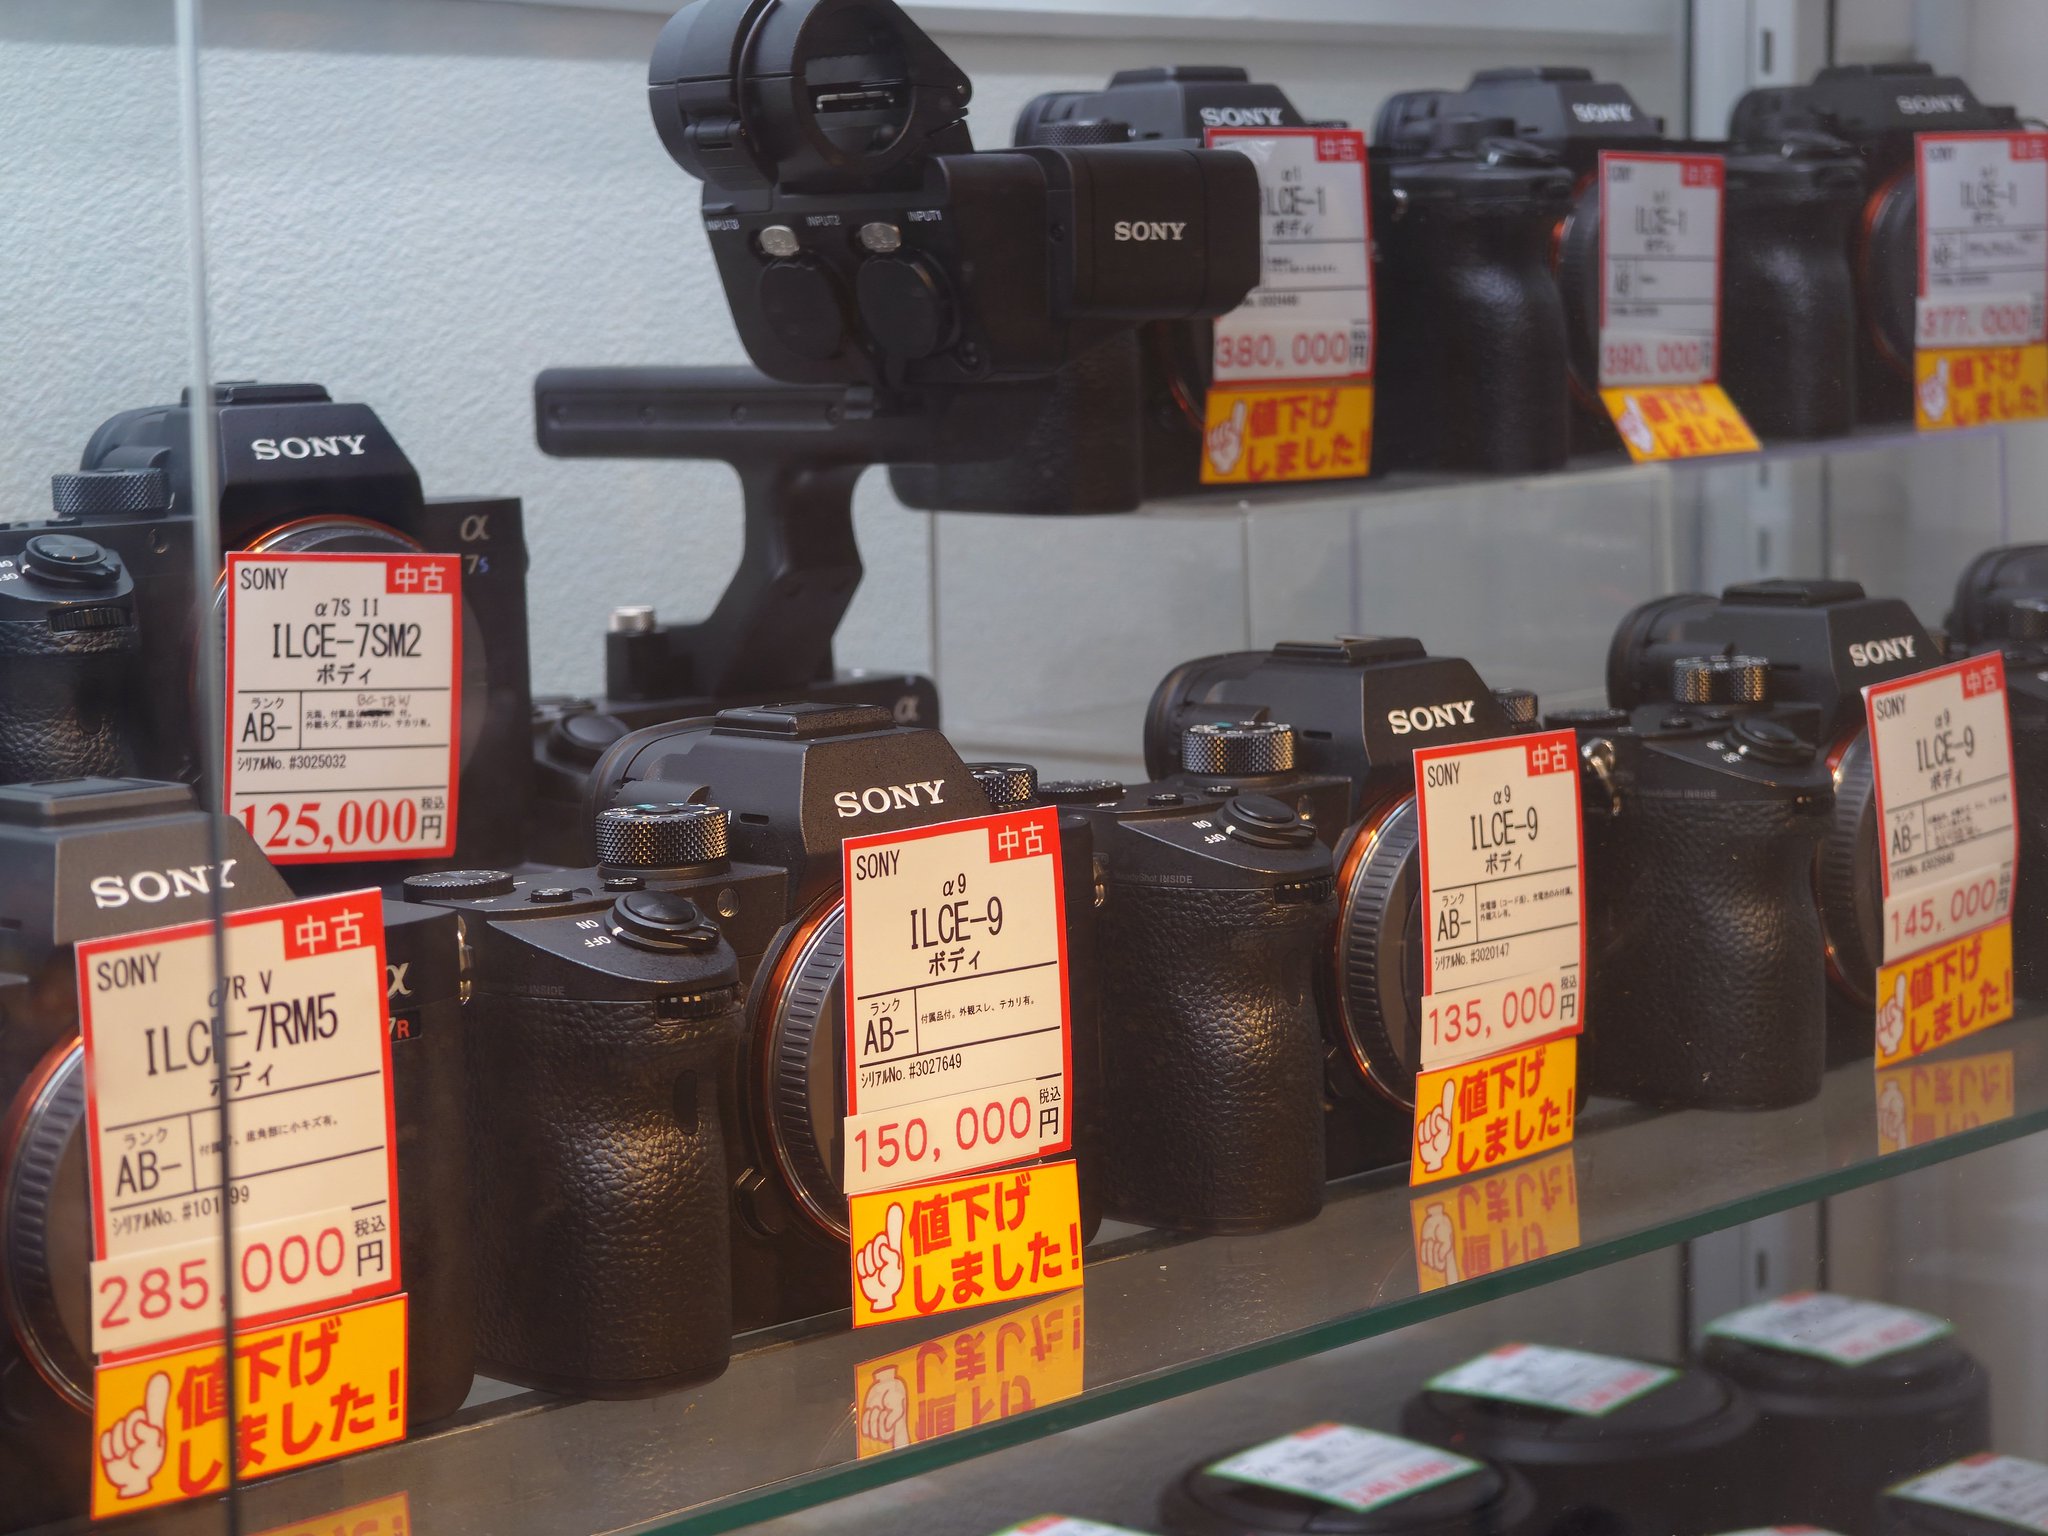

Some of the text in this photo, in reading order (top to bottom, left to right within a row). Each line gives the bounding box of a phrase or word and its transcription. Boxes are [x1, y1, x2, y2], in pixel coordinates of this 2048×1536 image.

[1200, 107, 1283, 126] SONY
[1572, 103, 1633, 122] SONY
[1897, 94, 1965, 114] SONY
[1114, 221, 1187, 241] SONY
[251, 434, 366, 461] SONY
[241, 567, 288, 590] SONY
[395, 562, 446, 593] 中古
[272, 623, 422, 658] ILCE-7SM2
[1849, 635, 1916, 667] SONY
[317, 664, 371, 685] ボディ
[1965, 665, 1997, 697] 中古
[252, 697, 284, 710] ランク
[1388, 700, 1475, 735] SONY
[1876, 695, 1906, 721] SONY
[242, 712, 292, 742] AB-
[289, 754, 347, 769] #3025032
[1532, 740, 1568, 774] 中古
[1916, 725, 1975, 772] ILCE-9
[1427, 761, 1461, 788] SONY
[834, 779, 945, 818] SONY
[240, 798, 417, 853] 125,000
[420, 815, 443, 841] 円
[1192, 819, 1213, 830] ON
[1204, 833, 1227, 844] OFF
[1470, 806, 1538, 851] ILCE-9
[997, 821, 1044, 859] 中古
[856, 849, 900, 881] SONY
[1485, 850, 1523, 875] ボディ
[943, 873, 966, 897] α9
[1160, 873, 1193, 884] INSIDE
[1441, 892, 1465, 908] ランク
[295, 908, 364, 954] 中古
[576, 919, 600, 930] ON
[910, 896, 1003, 950] ILCE-9
[1437, 908, 1471, 942] AB-
[584, 935, 612, 948] OFF
[1471, 943, 1509, 964] #3020147
[97, 952, 161, 992] SONY
[929, 947, 981, 977] ボディ
[1909, 933, 1983, 1010] 値下げ
[260, 970, 273, 994] V
[870, 997, 901, 1016] ランク
[1429, 982, 1555, 1046] 135,000
[1560, 993, 1576, 1020] 円
[864, 1016, 909, 1056] AB-
[909, 1053, 962, 1079] #3027649
[1039, 1086, 1061, 1105] 税込
[1458, 1046, 1547, 1125] 値下げ
[855, 1096, 1031, 1173] 150,000
[1039, 1106, 1059, 1139] 円
[1456, 1088, 1573, 1173] しました!
[124, 1127, 168, 1150] ランク
[116, 1150, 182, 1197] AB-
[182, 1185, 250, 1221] #10199
[909, 1172, 1031, 1257] 値下げ
[353, 1214, 386, 1238] 税込
[357, 1240, 384, 1277] 円
[913, 1222, 1079, 1314] しました!
[99, 1226, 346, 1329] 285,000
[177, 1315, 342, 1431] 値下げ
